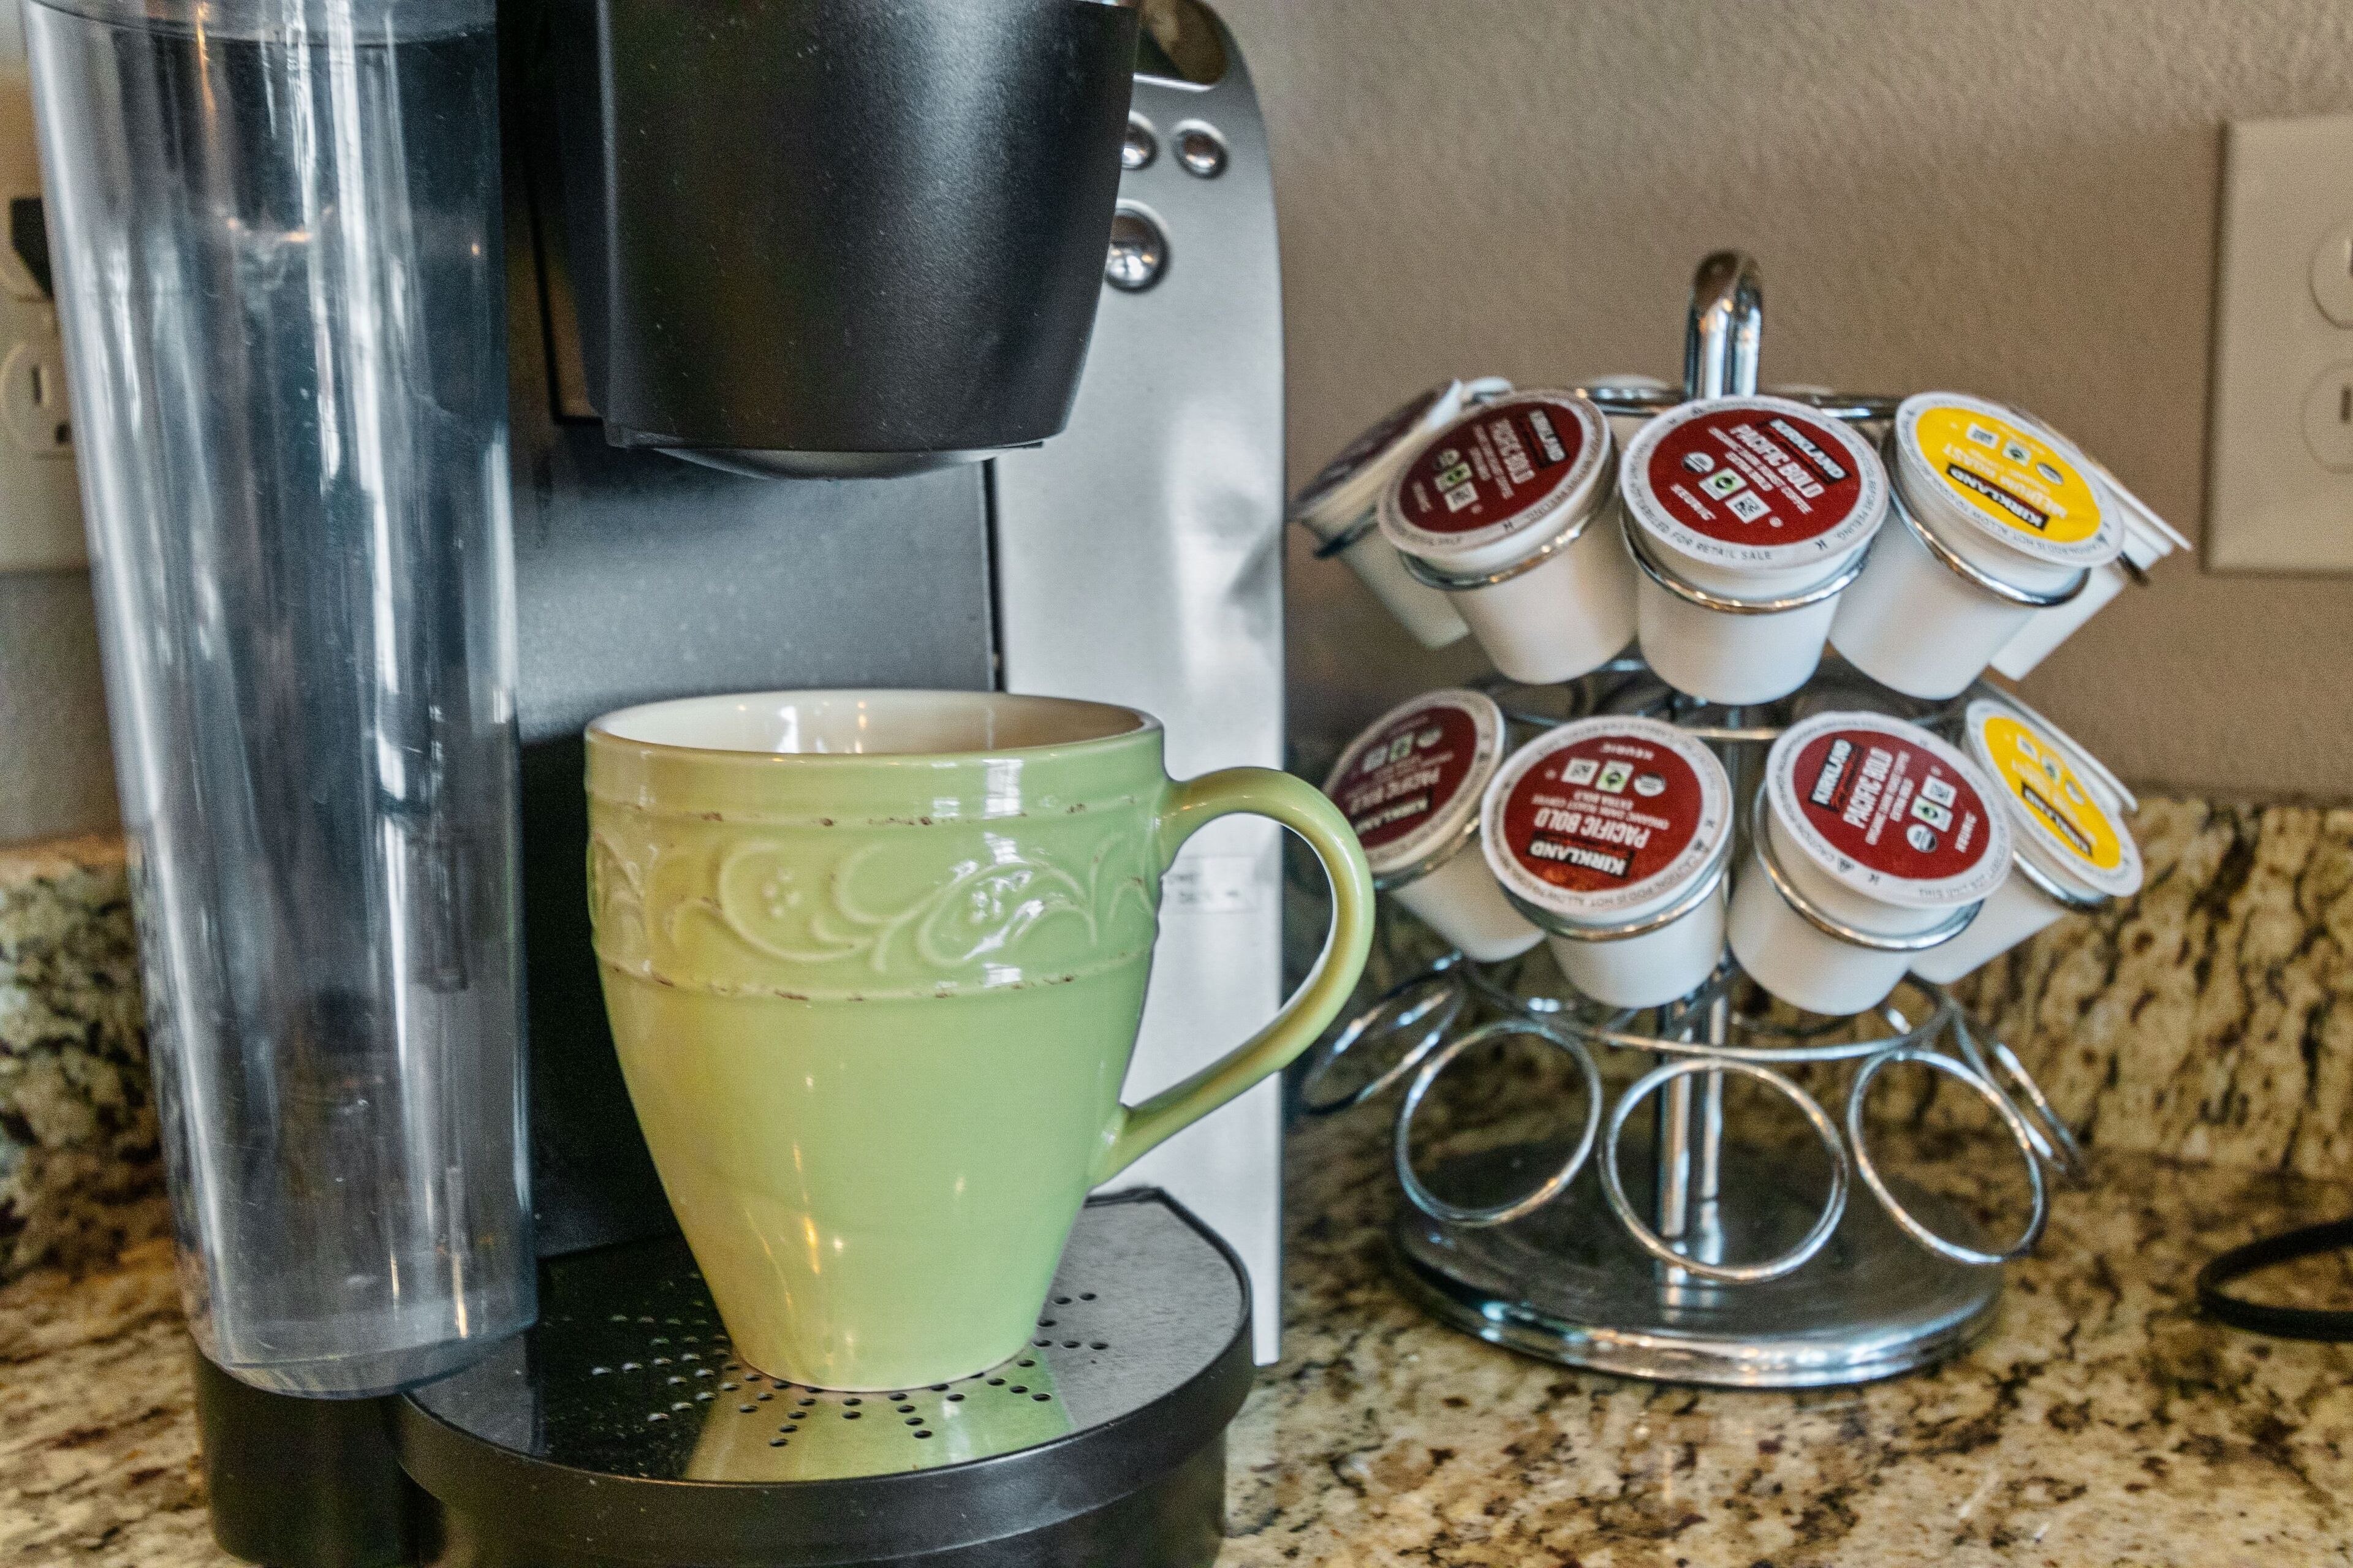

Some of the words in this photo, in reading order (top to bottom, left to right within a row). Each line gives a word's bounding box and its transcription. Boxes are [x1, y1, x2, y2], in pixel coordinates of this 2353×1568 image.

[1727, 422, 1791, 469] PACIFIC
[1775, 460, 1827, 500] BOLD
[1768, 417, 1847, 480] KIRKLAND
[1943, 443, 1996, 479] ROAST
[1668, 483, 1717, 521] KEURIG
[1778, 485, 1814, 515] COFFEE
[1950, 468, 2043, 528] KIRKLAND
[2000, 475, 2067, 520] MEDIUM
[1669, 530, 1696, 547] FOR
[1694, 541, 1736, 558] RETAIL
[1740, 550, 1773, 559] SALE
[1598, 742, 1654, 761] KEURIG
[1862, 745, 1893, 782] BOLD
[1812, 737, 1853, 805] KIRKLAND
[1533, 806, 1582, 834] BOLD
[1843, 774, 1882, 829] PACIFIC
[1579, 814, 1650, 849] PACIFIC
[1953, 810, 1977, 852] KEURIG
[1529, 839, 1627, 876] KIRKLAND
